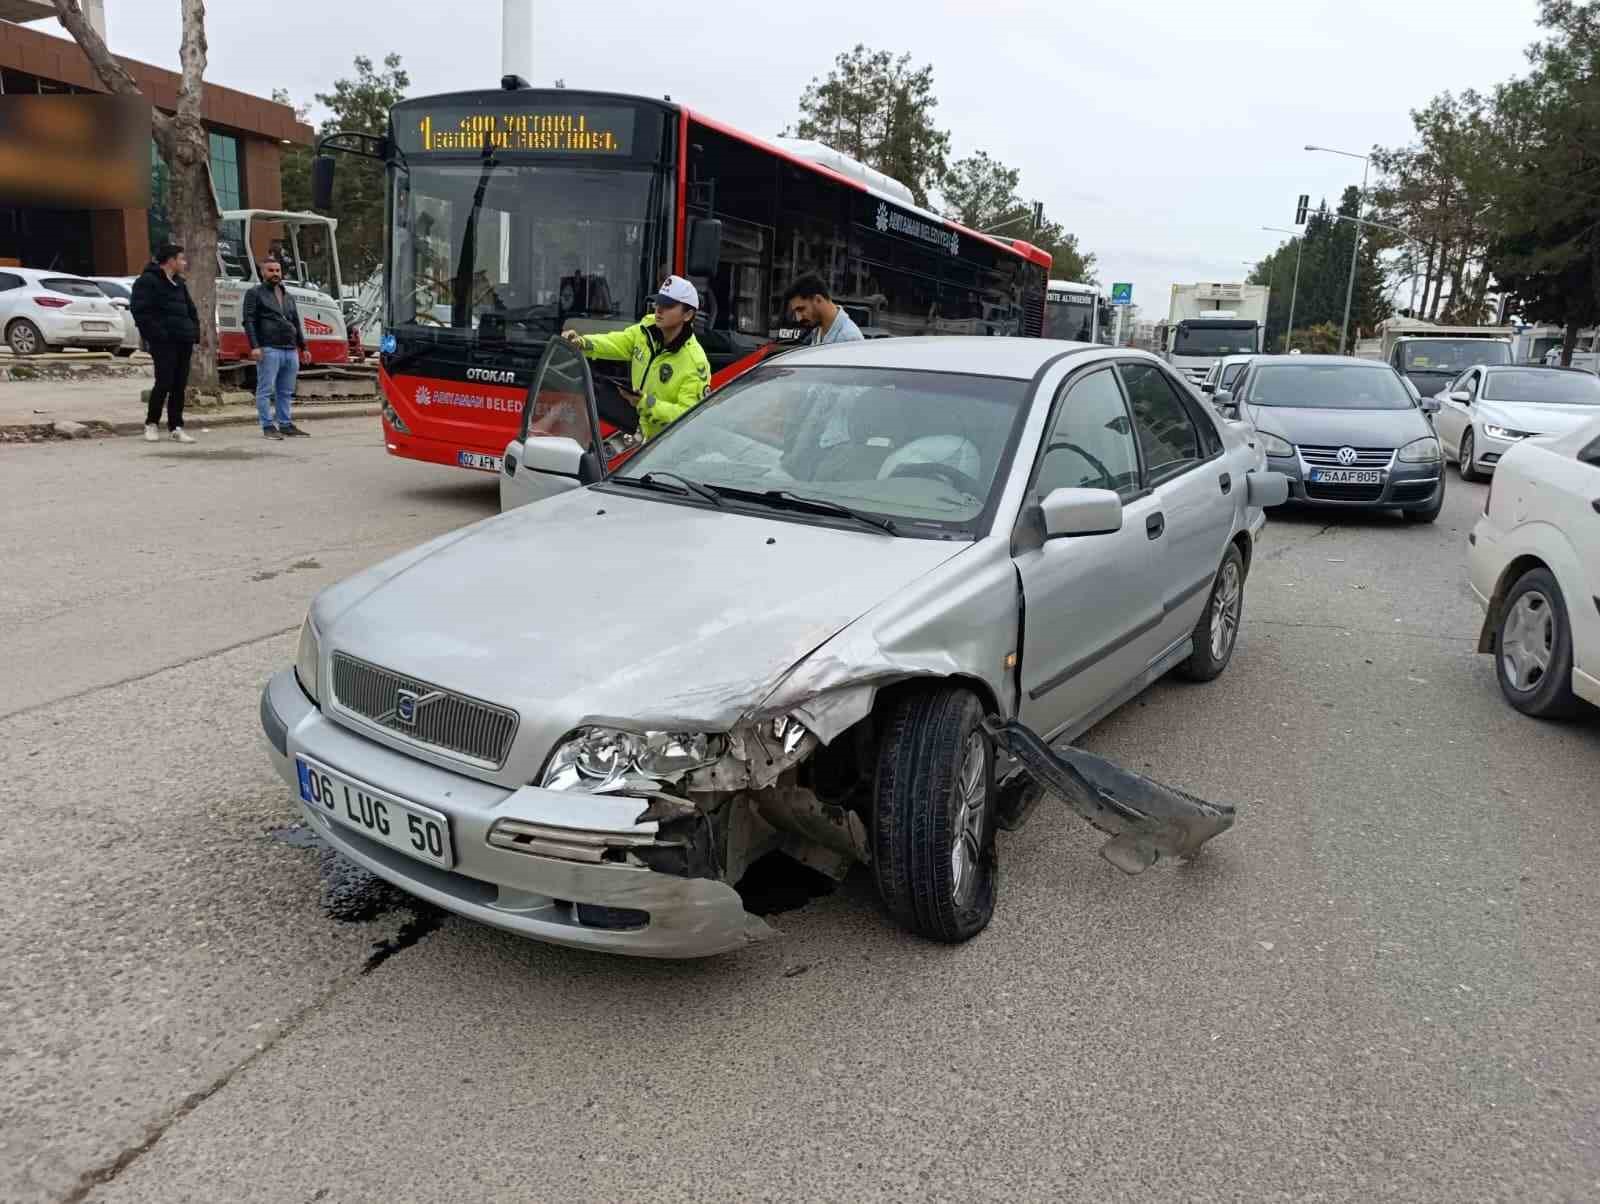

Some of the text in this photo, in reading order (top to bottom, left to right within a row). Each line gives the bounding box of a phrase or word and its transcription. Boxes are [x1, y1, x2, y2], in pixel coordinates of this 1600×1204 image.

[420, 115, 432, 150] 1
[466, 368, 516, 384] OTOKAR
[486, 397, 526, 413] BELED
[463, 452, 474, 466] 02
[308, 768, 443, 857] 06 LUG 50
